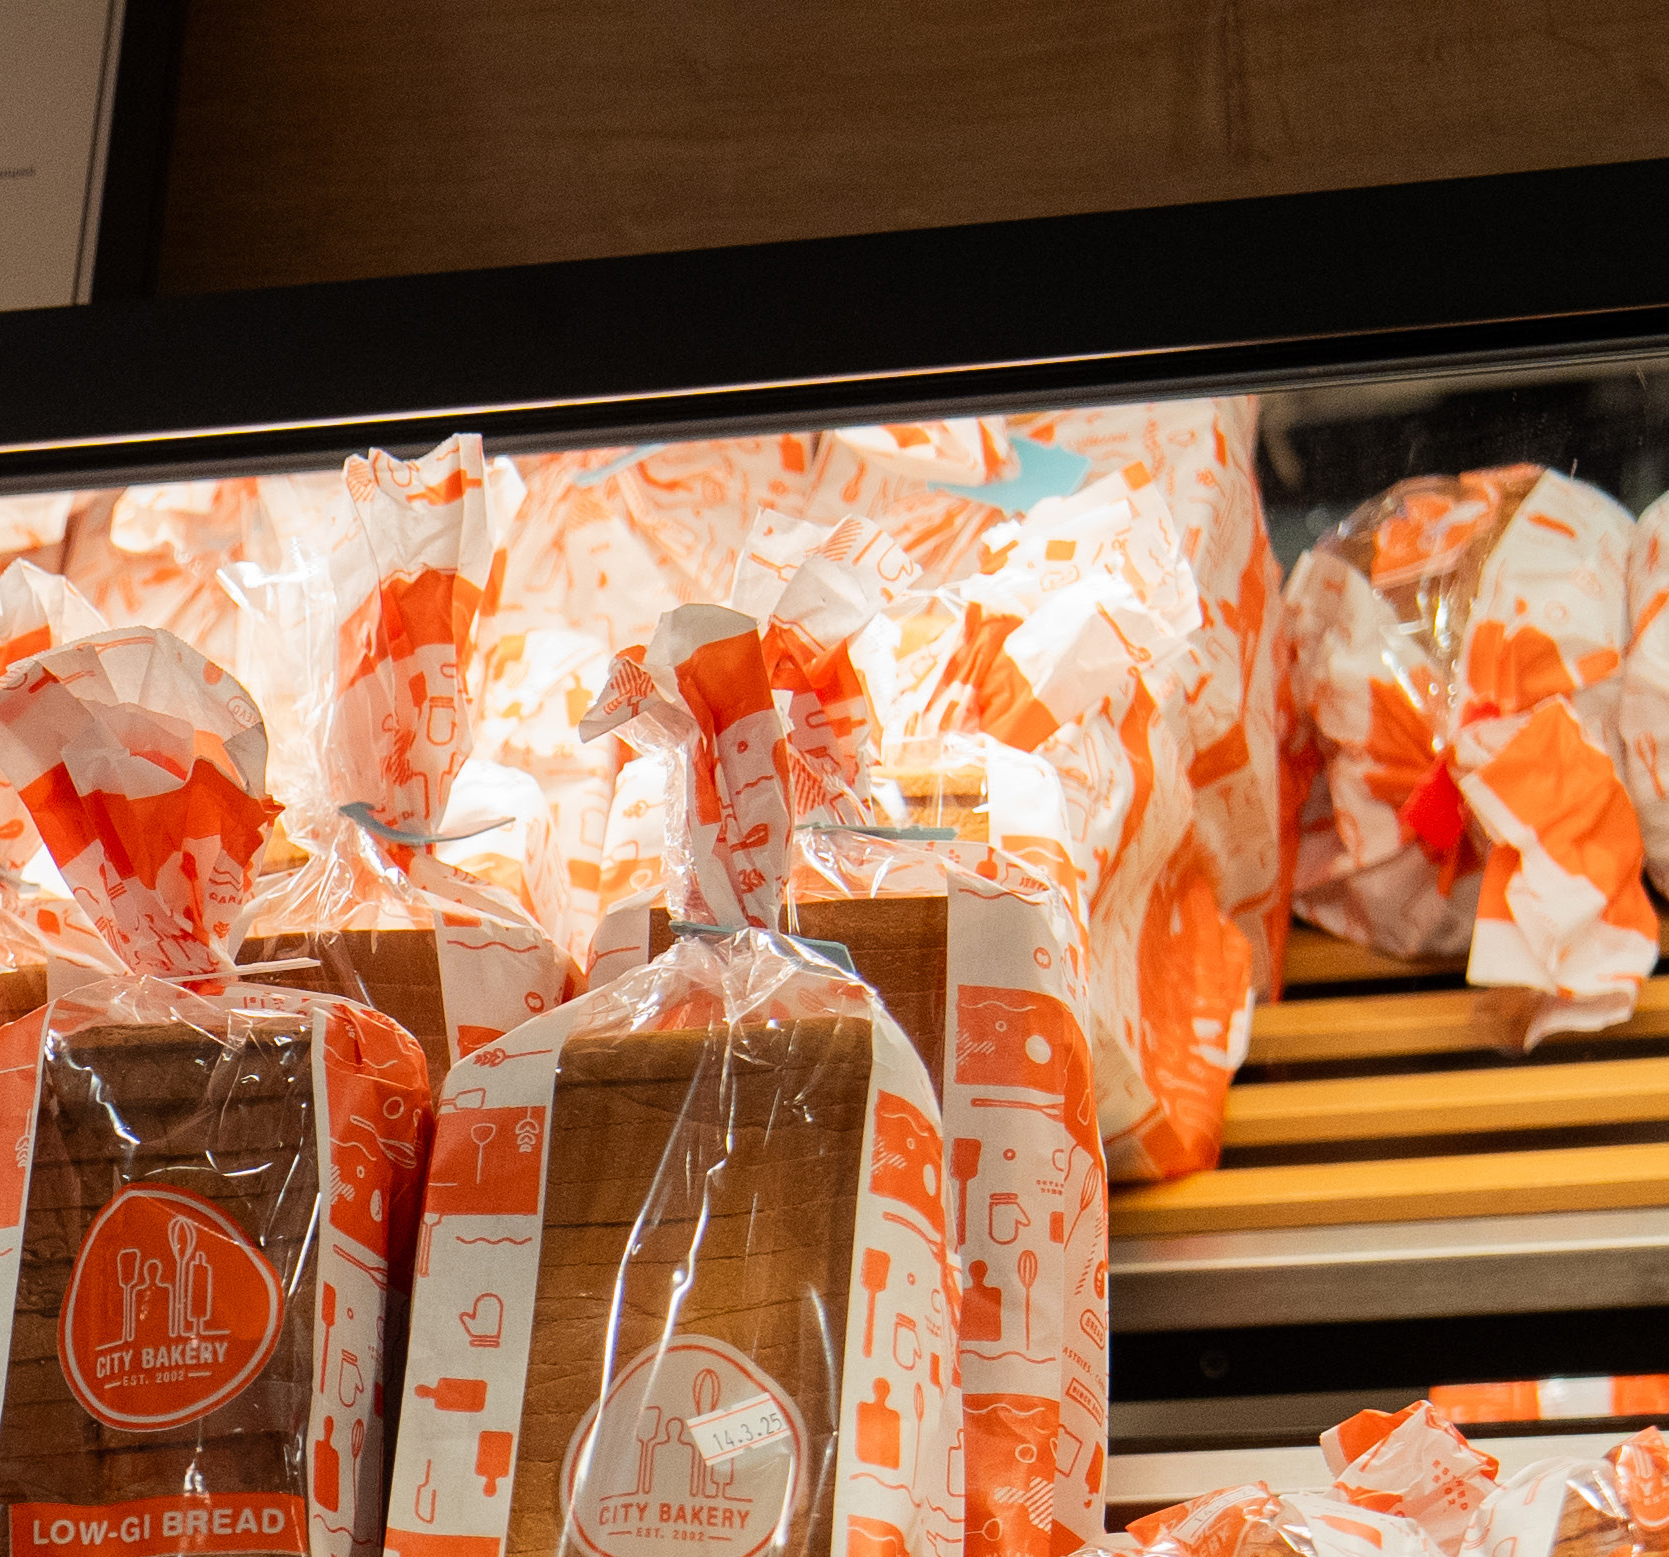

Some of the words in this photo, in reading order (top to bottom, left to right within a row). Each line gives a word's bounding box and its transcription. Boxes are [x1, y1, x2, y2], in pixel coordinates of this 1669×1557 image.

[96, 1352, 132, 1378] CITY
[141, 1341, 228, 1370] BAKERY
[122, 1375, 148, 1387] EST.
[155, 1370, 186, 1383] 2002
[712, 1411, 782, 1452] 14.3.25
[33, 1514, 151, 1546] LOW-GI
[162, 1507, 286, 1538] BREAD
[599, 1503, 649, 1526] CITY
[658, 1502, 751, 1530] BAKERY
[635, 1527, 665, 1540] EST.
[672, 1530, 705, 1542] 2002
